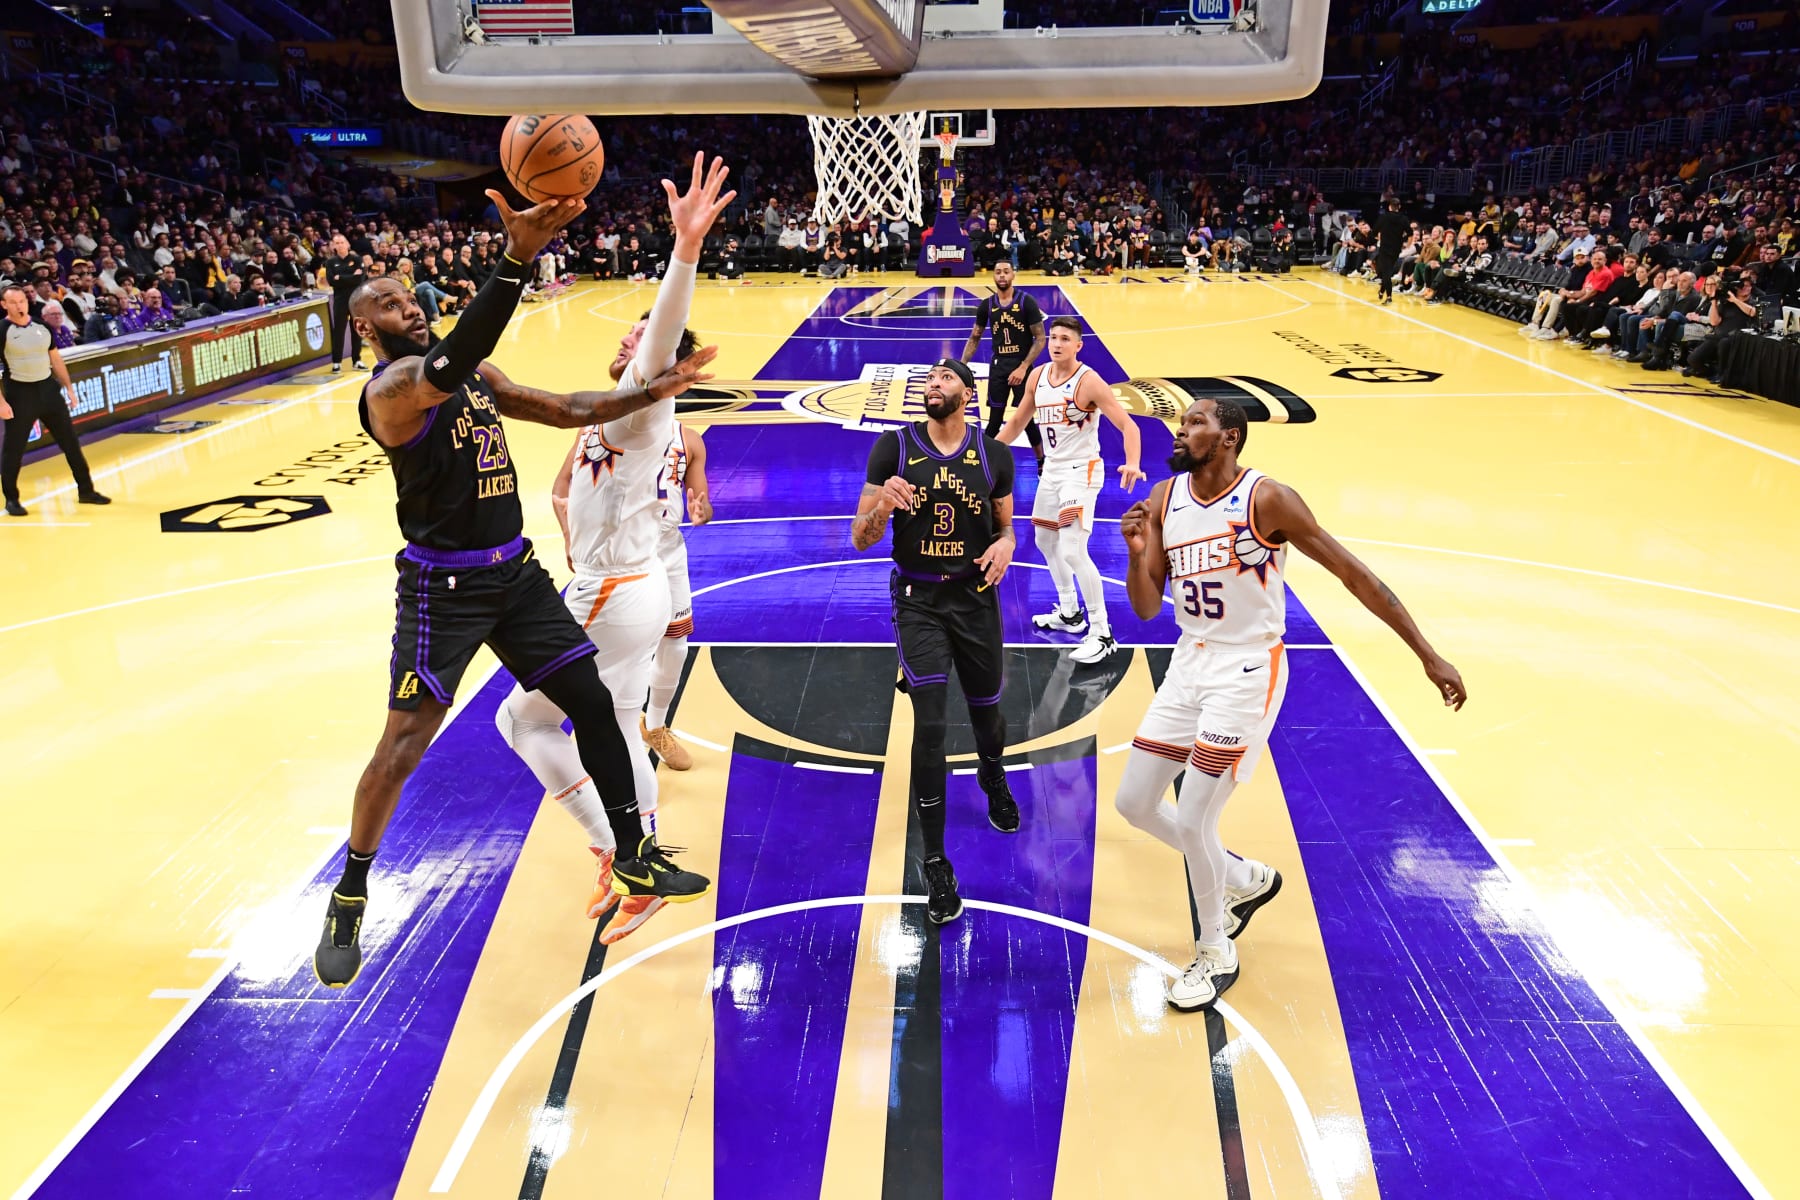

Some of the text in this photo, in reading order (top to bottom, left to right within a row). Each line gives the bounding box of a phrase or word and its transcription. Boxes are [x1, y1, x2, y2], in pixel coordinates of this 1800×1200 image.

[1198, 0, 1224, 14] NBA
[337, 132, 368, 142] ULTRA
[1078, 275, 1307, 285] LAKERS
[998, 344, 1020, 354] LAKERS
[1003, 327, 1012, 345] 1
[192, 319, 302, 387] KNOCKOUT ROUNDS
[101, 350, 173, 414] TOURNAMENT
[863, 366, 896, 412] LOS ANGELES
[451, 406, 474, 450] LOS
[1046, 426, 1057, 448] 8
[471, 424, 509, 473] 23
[477, 473, 515, 500] LAKERS
[909, 466, 983, 516] LOS ANGELES
[933, 502, 955, 537] 3
[920, 539, 964, 557] LAKERS
[1168, 535, 1232, 578] SUNS
[1182, 579, 1225, 620] 35
[395, 671, 418, 699] LA
[1200, 730, 1242, 745] PHOENIX
